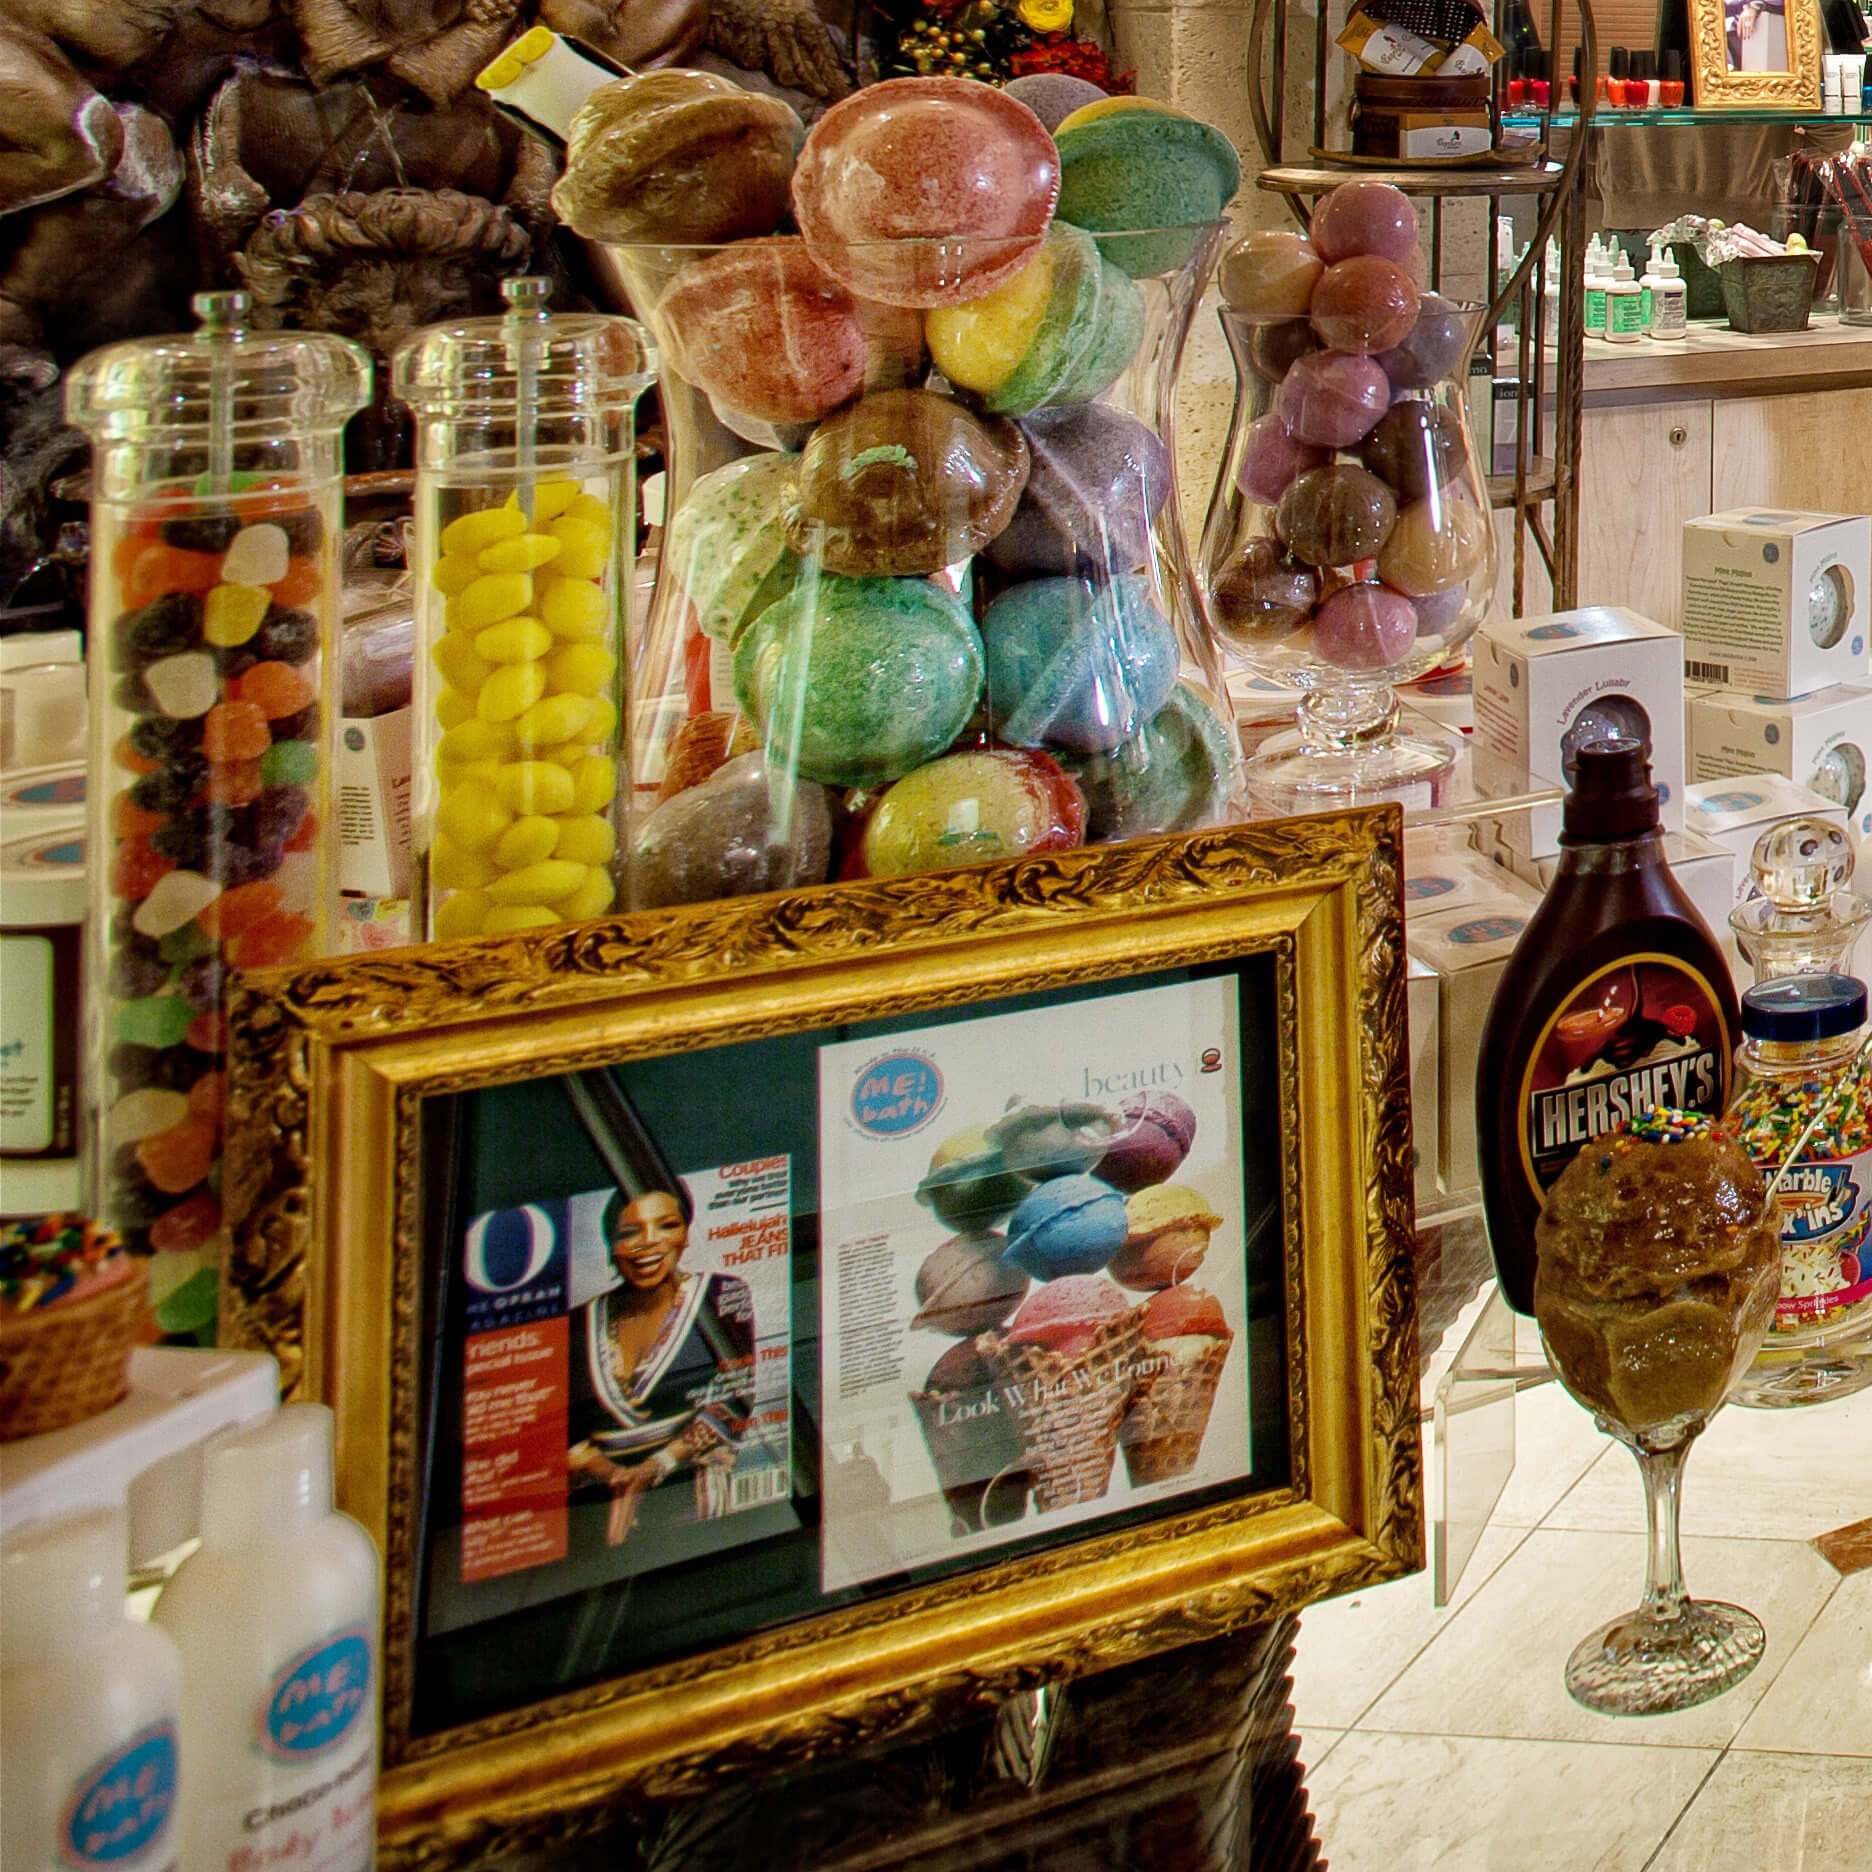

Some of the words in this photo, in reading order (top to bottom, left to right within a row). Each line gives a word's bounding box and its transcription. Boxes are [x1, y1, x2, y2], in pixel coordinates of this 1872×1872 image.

[1556, 686, 1593, 726] Lavender
[1595, 677, 1632, 691] Lullaby
[859, 1071, 927, 1101] ME!
[1083, 1062, 1185, 1098] beauty
[862, 1095, 929, 1123] bath
[1542, 1052, 1715, 1149] HERSHEY'S
[708, 1214, 789, 1241] Hallelujah
[739, 1229, 788, 1250] JEANS
[464, 1203, 555, 1293] O
[722, 1246, 763, 1267] THAT
[493, 1285, 562, 1310] OPRAH
[469, 1303, 560, 1329] AGAZINE
[467, 1331, 541, 1360] riends:
[466, 1354, 512, 1377] pecial
[938, 1389, 1000, 1427] Look
[1002, 1377, 1067, 1410] What
